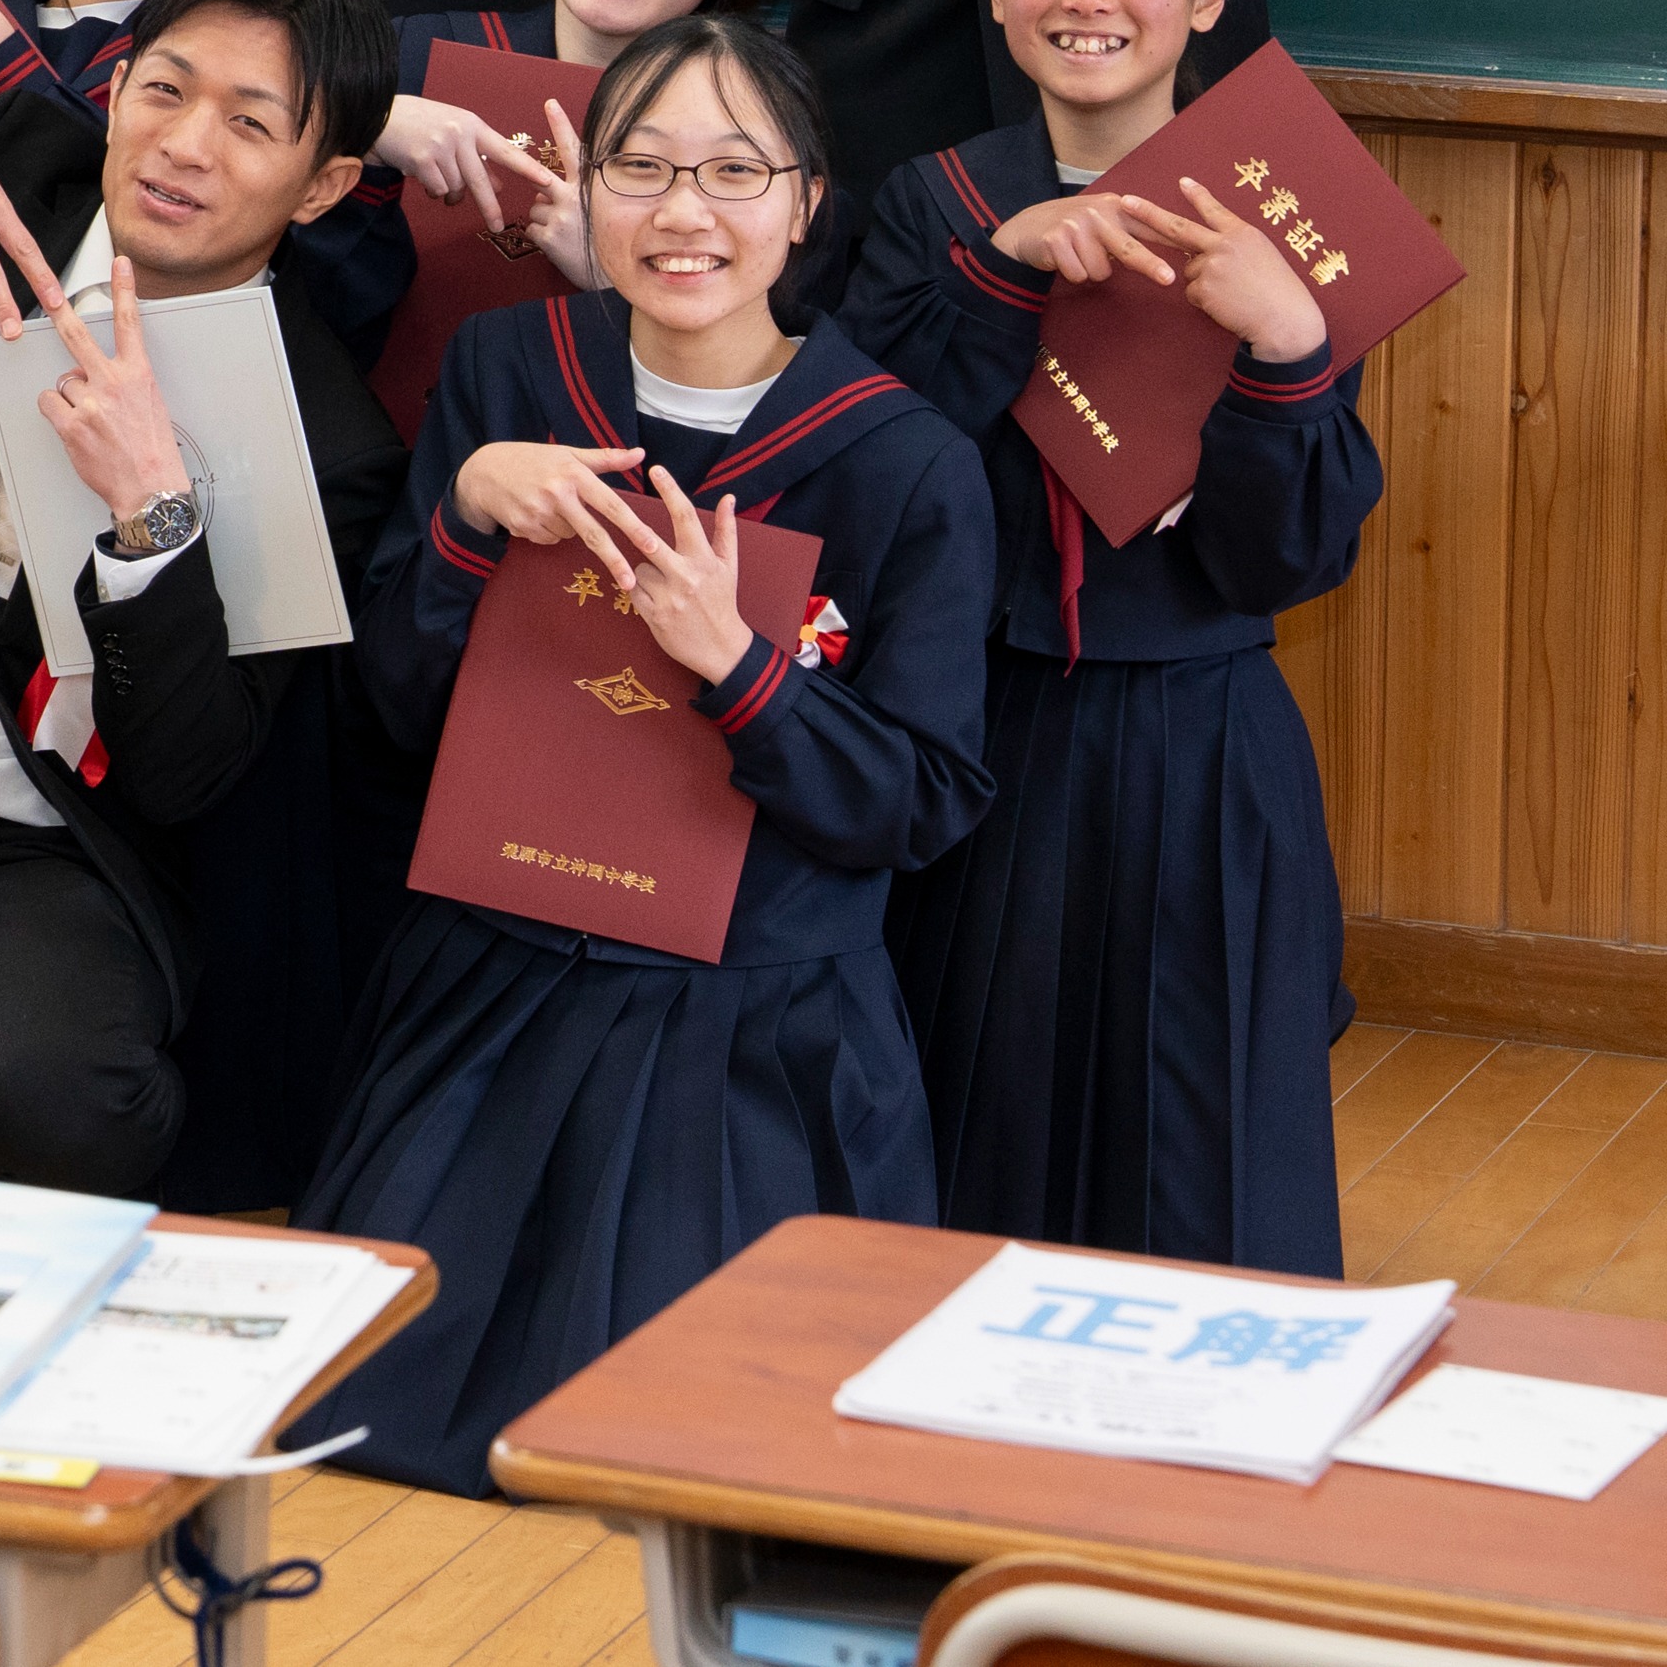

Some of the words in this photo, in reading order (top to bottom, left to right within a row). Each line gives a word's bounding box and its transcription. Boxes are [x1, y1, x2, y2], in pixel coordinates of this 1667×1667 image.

[1233, 155, 1354, 287] 卒業証書
[981, 1280, 1375, 1374] 正解
